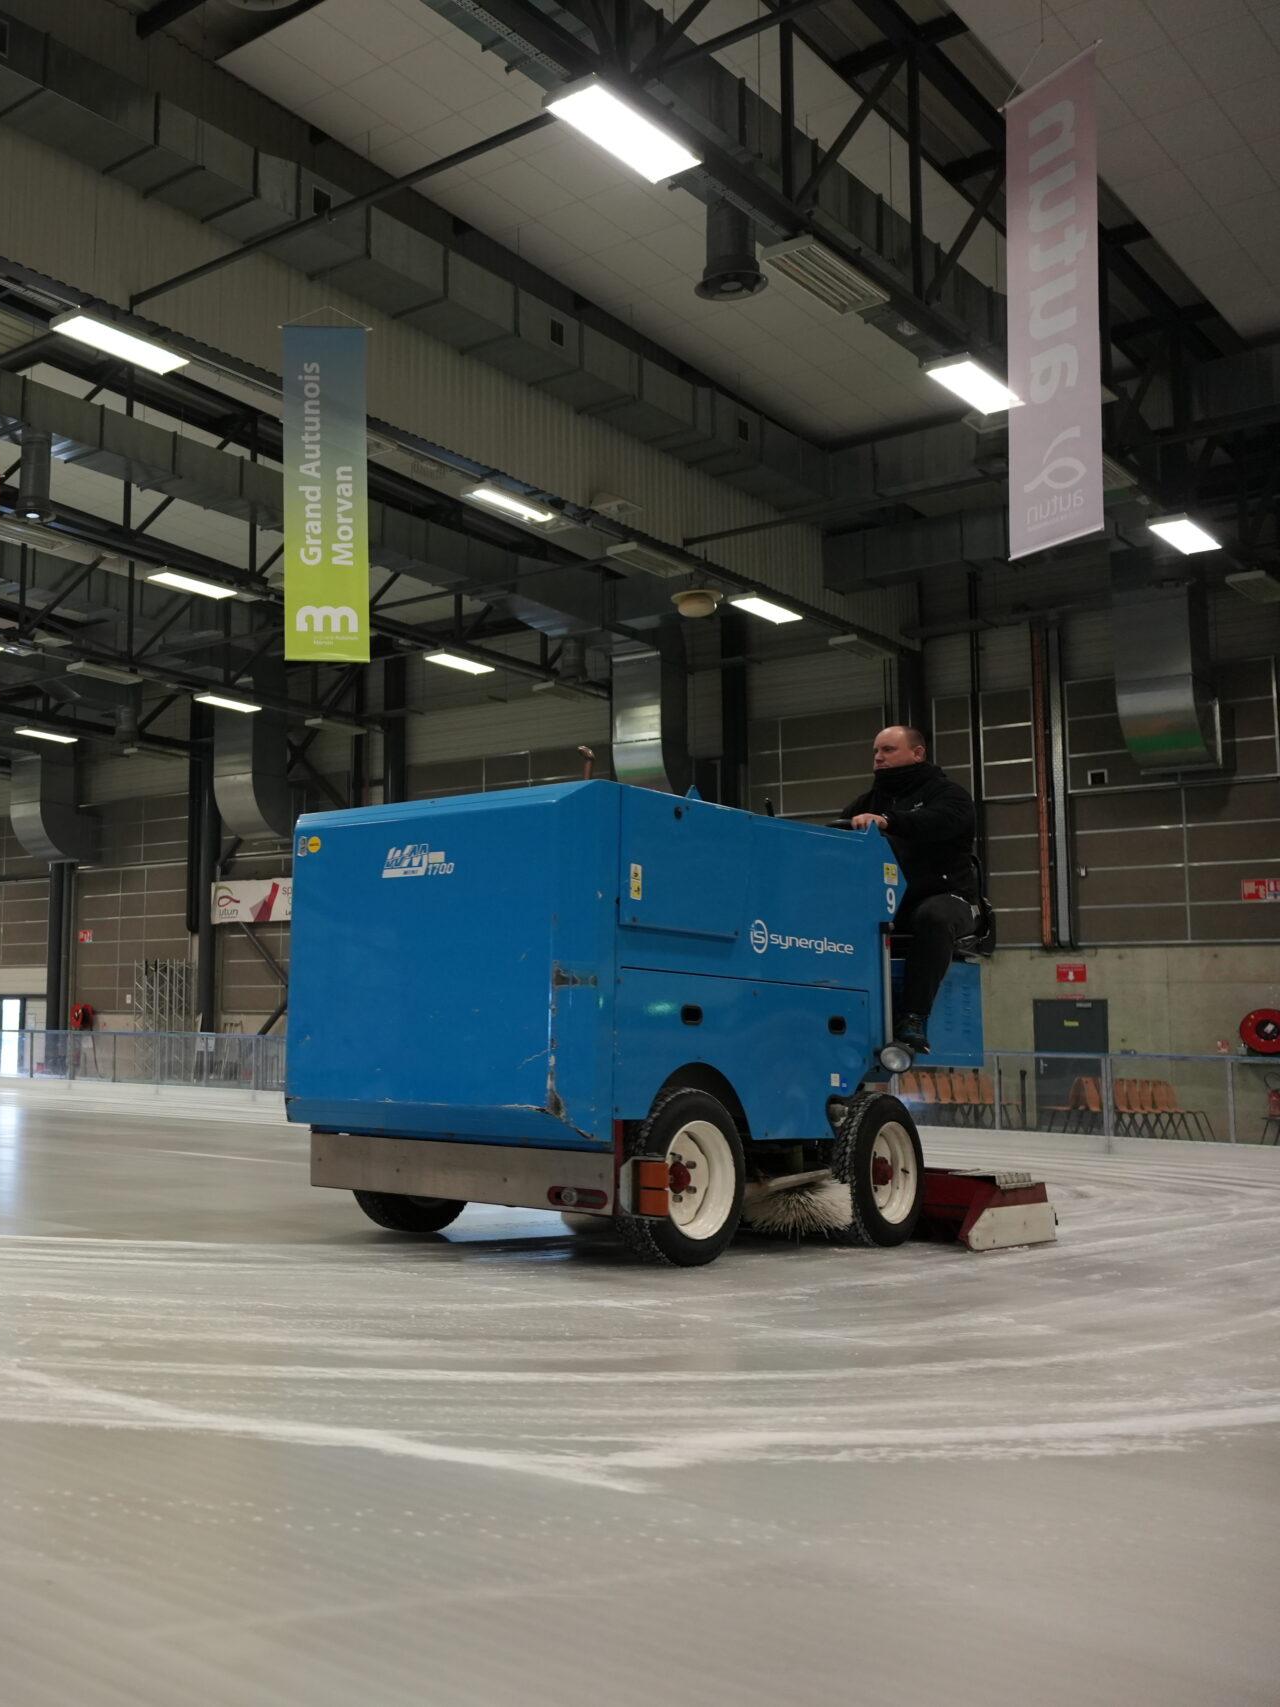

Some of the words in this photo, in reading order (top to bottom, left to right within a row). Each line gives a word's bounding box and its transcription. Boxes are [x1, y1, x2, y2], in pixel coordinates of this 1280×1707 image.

[298, 361, 321, 478] Autunois
[298, 486, 322, 566] Grand
[332, 465, 355, 566] Morvan
[427, 862, 455, 876] 1700
[886, 887, 896, 914] 9
[770, 934, 854, 955] synerglace
